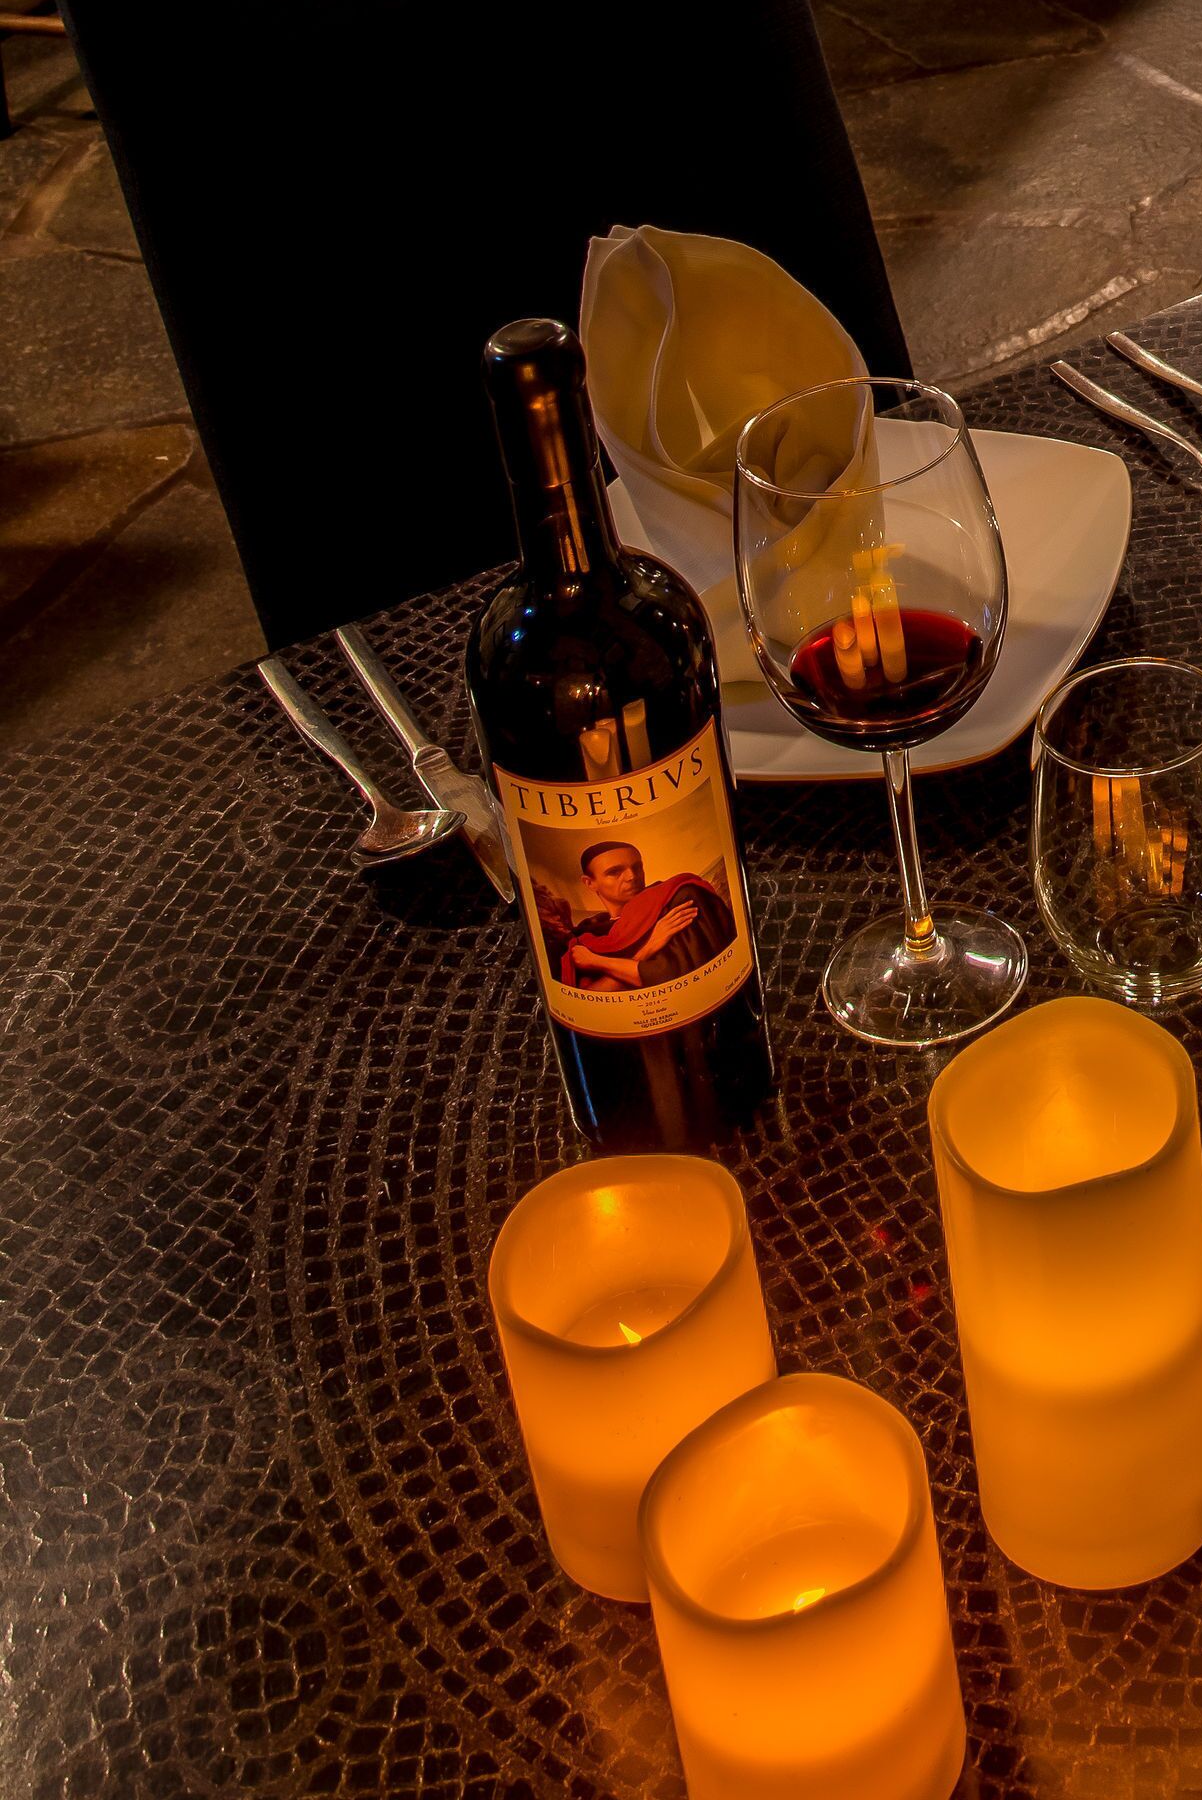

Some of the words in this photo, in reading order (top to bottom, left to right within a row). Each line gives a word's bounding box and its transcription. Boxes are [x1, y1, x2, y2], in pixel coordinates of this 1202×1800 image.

[510, 746, 703, 818] TIBERIVS
[560, 986, 625, 1004] CARBONELL
[692, 974, 701, 984] &
[703, 949, 734, 977] MATEO
